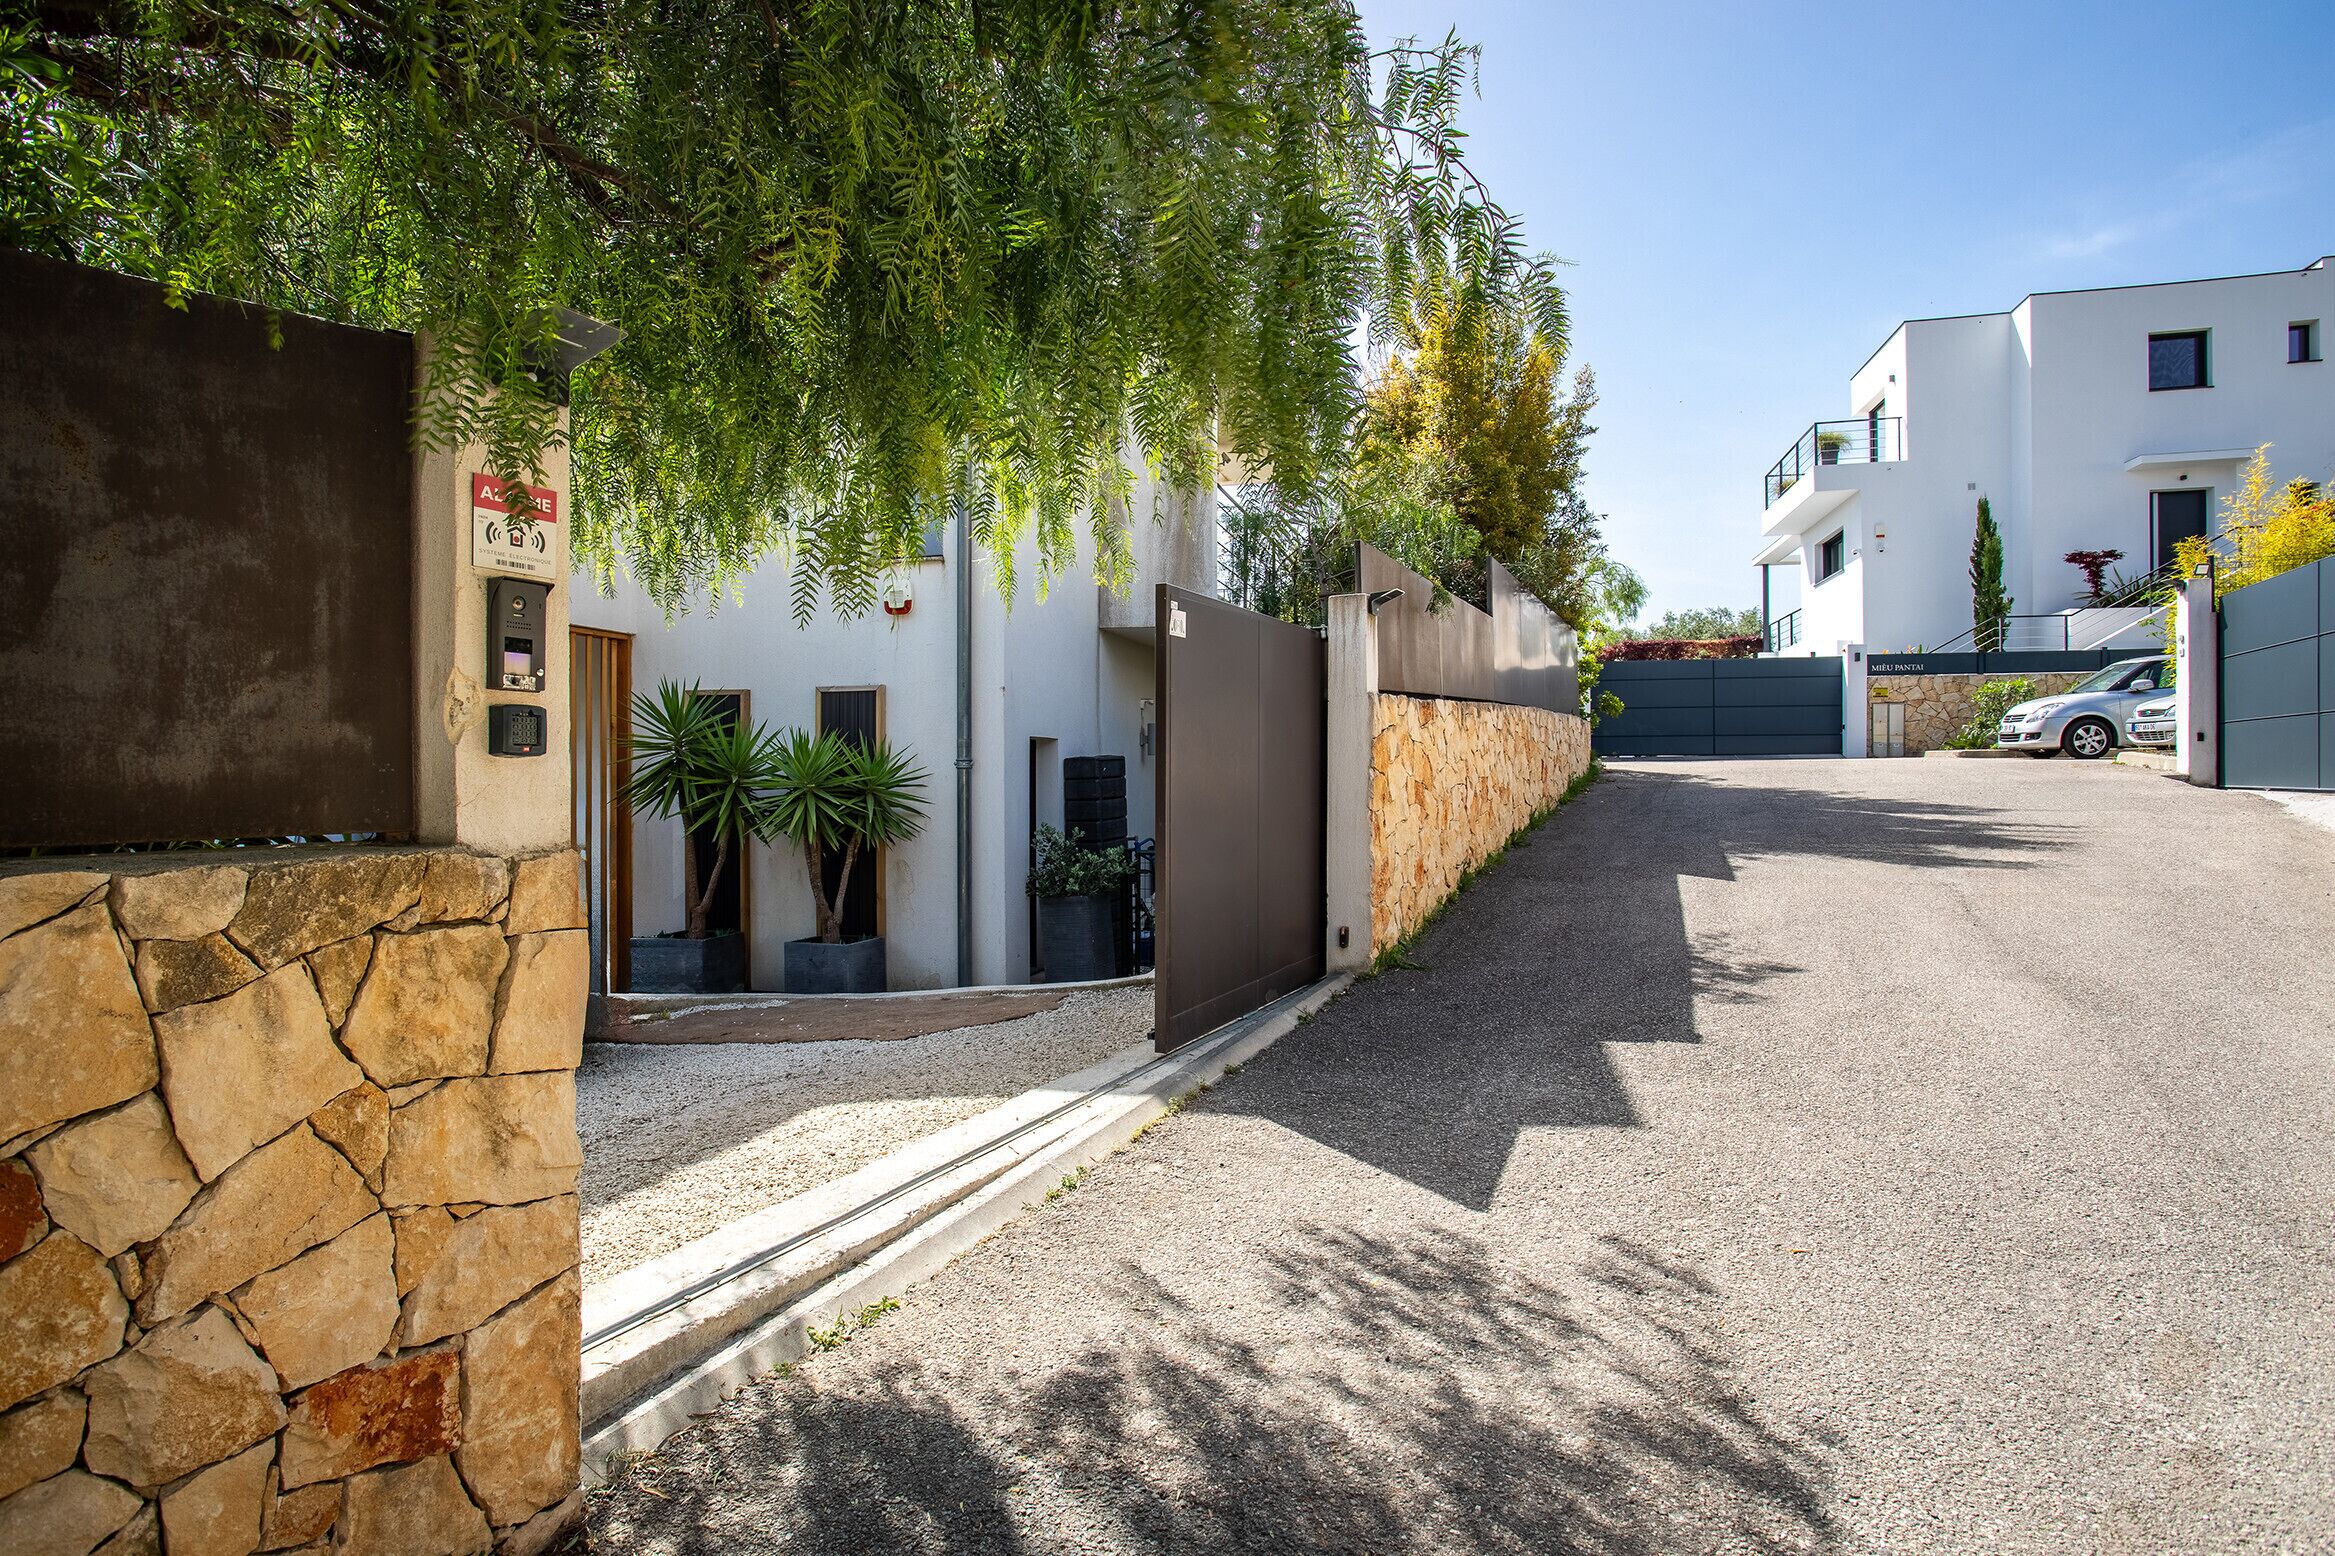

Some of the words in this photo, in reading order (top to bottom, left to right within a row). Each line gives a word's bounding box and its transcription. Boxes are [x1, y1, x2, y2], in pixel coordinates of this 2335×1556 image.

[480, 485, 551, 513] ALME
[479, 548, 506, 557] SYSTEME
[509, 553, 551, 565] ELECTRONIQUE
